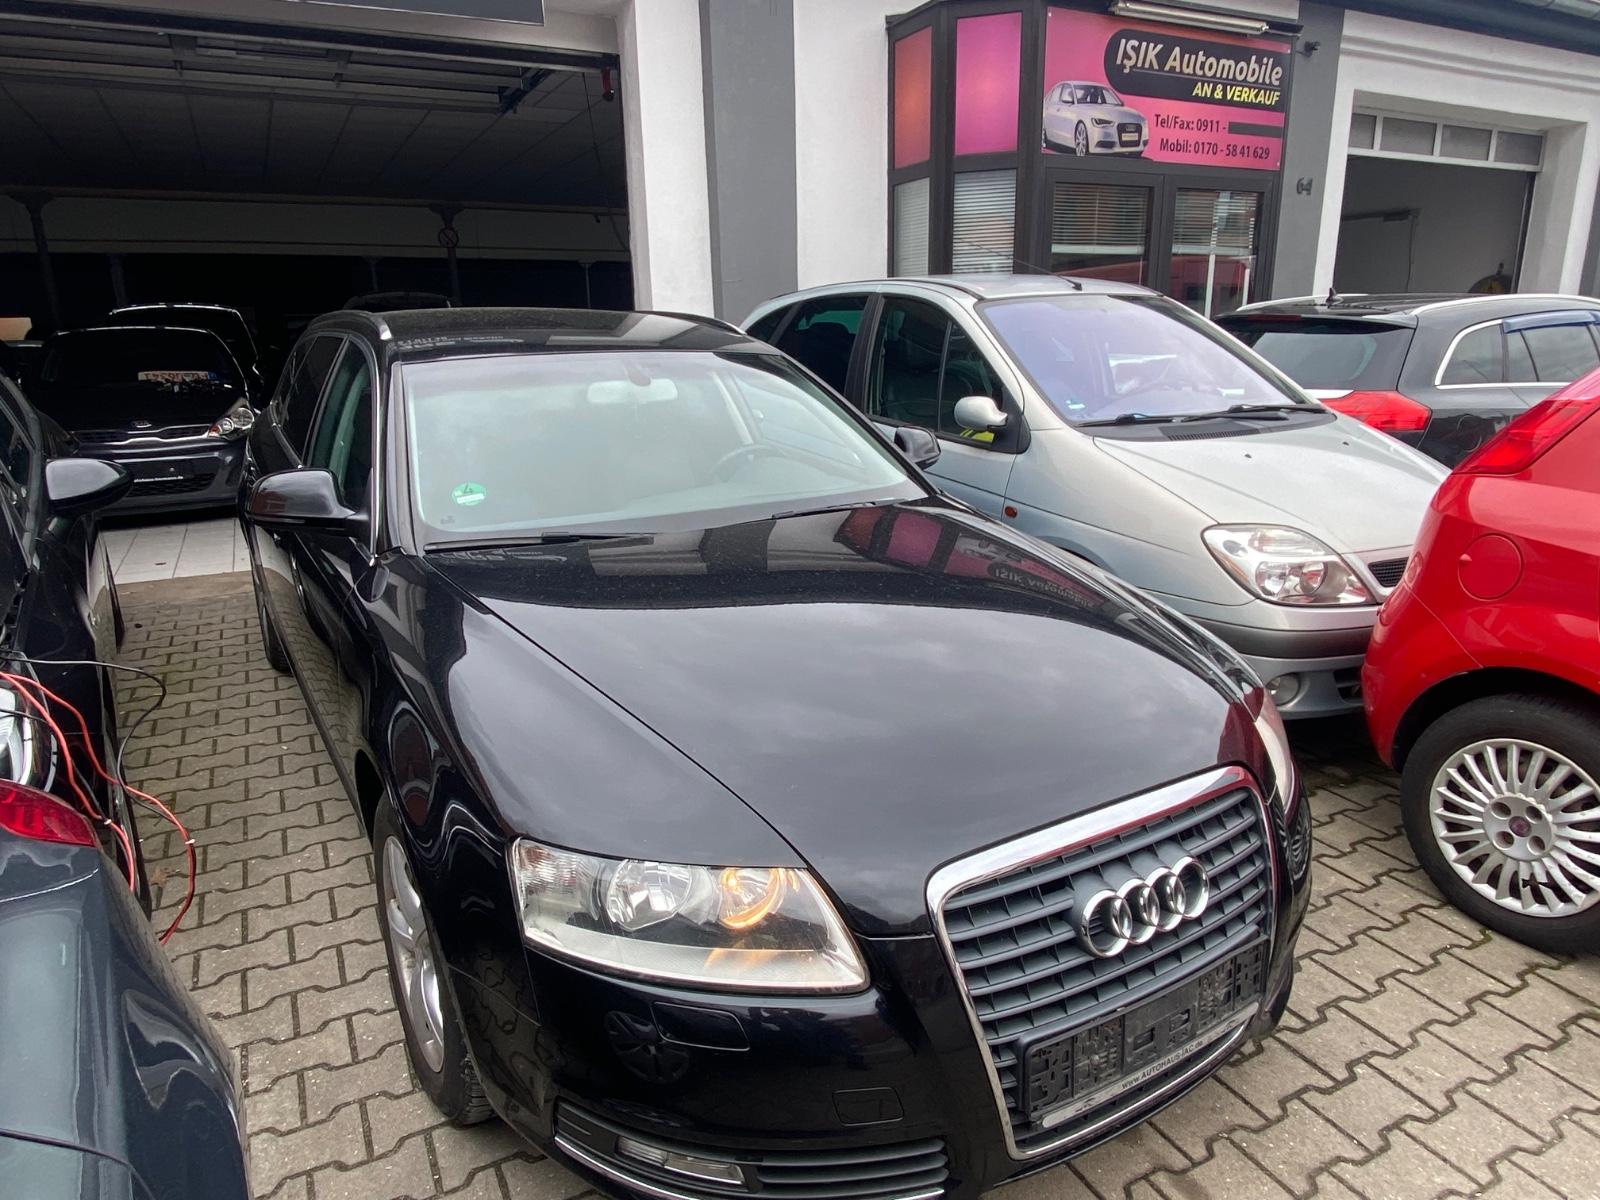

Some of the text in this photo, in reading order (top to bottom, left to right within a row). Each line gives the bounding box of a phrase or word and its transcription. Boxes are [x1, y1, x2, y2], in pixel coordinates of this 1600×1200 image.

[1116, 38, 1283, 86] IŞIK Automobile
[1192, 81, 1281, 106] AN & VERKAUF
[1155, 114, 1194, 131] Tel/Fax:
[1196, 118, 1220, 133] 0911
[1160, 138, 1192, 153] Mobil:
[1193, 141, 1218, 156] 0170
[1225, 143, 1238, 157] 58
[1239, 145, 1251, 158] 41
[1252, 146, 1270, 160] 629
[1296, 177, 1313, 196] 64
